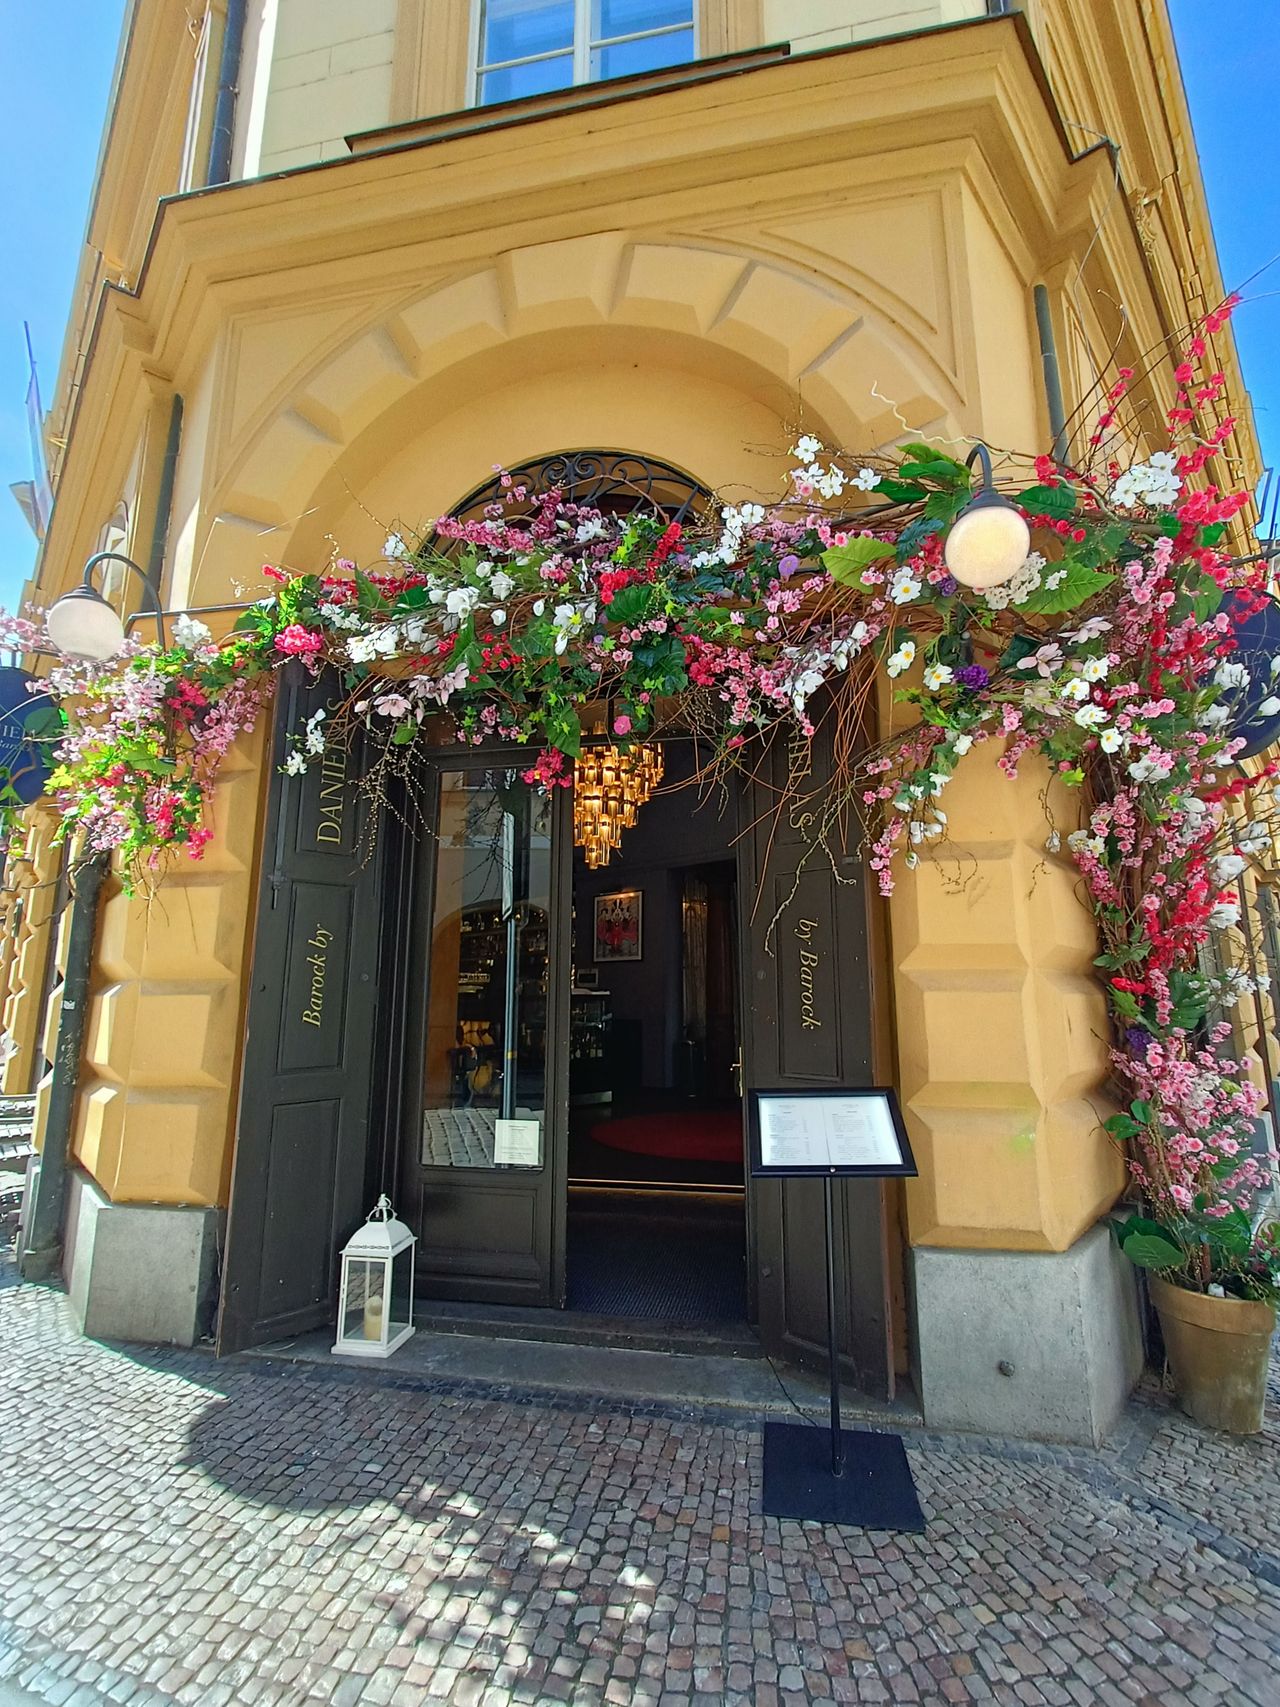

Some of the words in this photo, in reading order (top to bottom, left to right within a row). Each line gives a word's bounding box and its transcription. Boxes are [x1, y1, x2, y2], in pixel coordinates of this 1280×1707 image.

[307, 923, 334, 949] by
[794, 919, 819, 945] by
[302, 954, 327, 1028] Barock
[800, 948, 822, 1030] Barock
